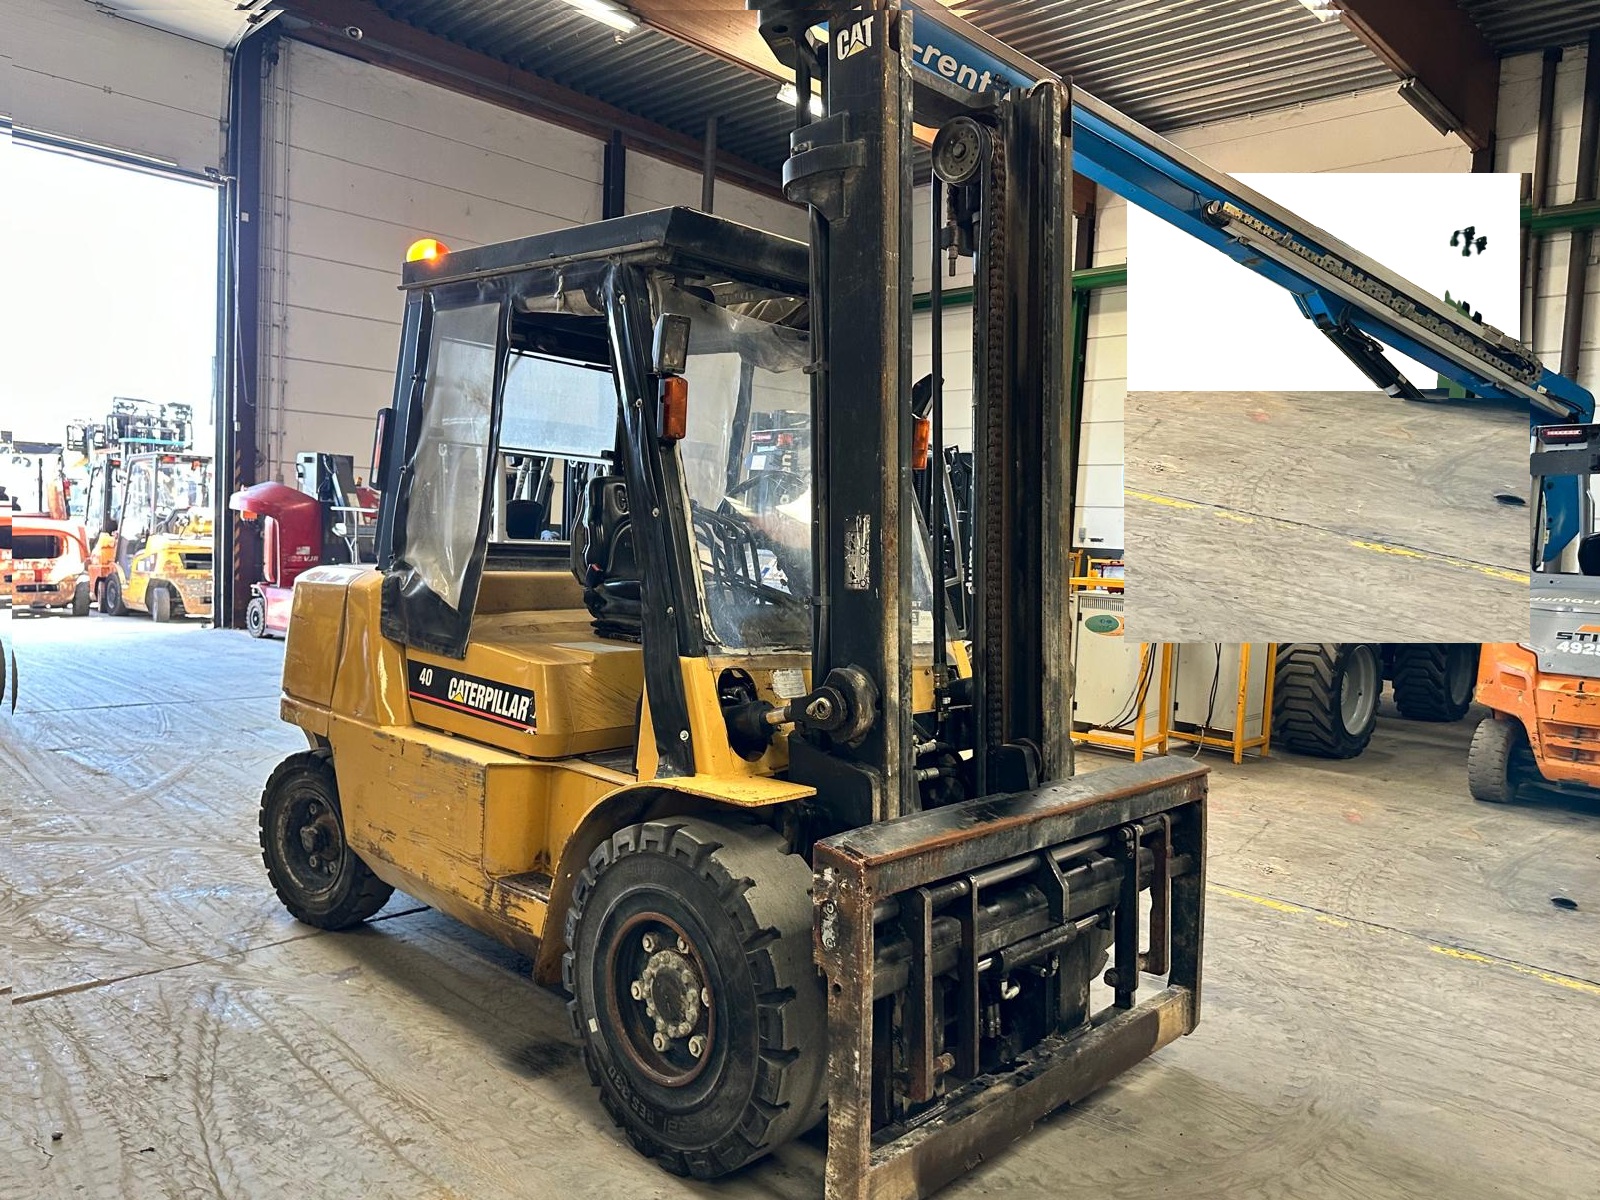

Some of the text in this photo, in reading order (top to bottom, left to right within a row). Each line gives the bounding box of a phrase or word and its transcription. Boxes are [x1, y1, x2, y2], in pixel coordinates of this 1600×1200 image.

[836, 15, 875, 61] CAT
[418, 667, 433, 687] 40
[447, 676, 531, 722] CATERPILLAR
